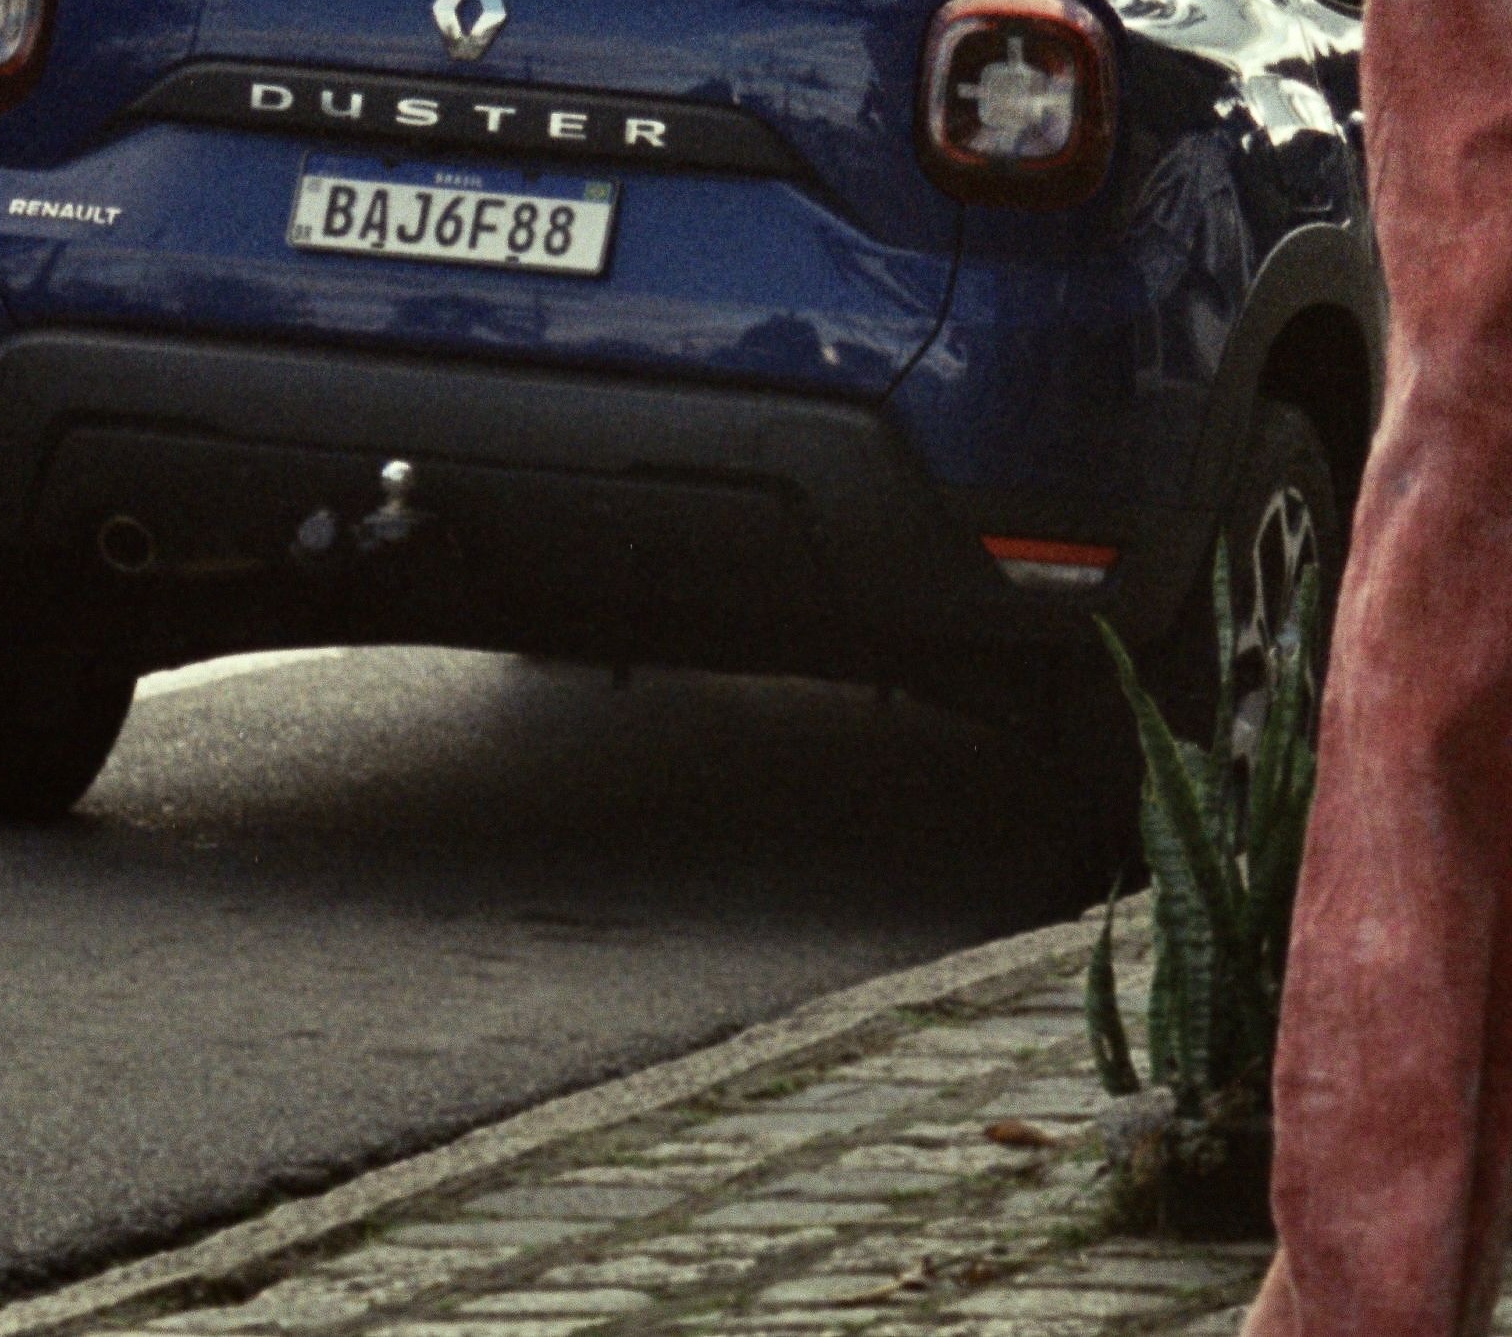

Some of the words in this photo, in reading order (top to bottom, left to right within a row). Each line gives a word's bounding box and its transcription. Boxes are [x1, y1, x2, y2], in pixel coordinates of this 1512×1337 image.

[251, 83, 666, 147] DUSTER
[8, 198, 122, 226] RENAULT
[322, 185, 576, 256] BAJ6F88
